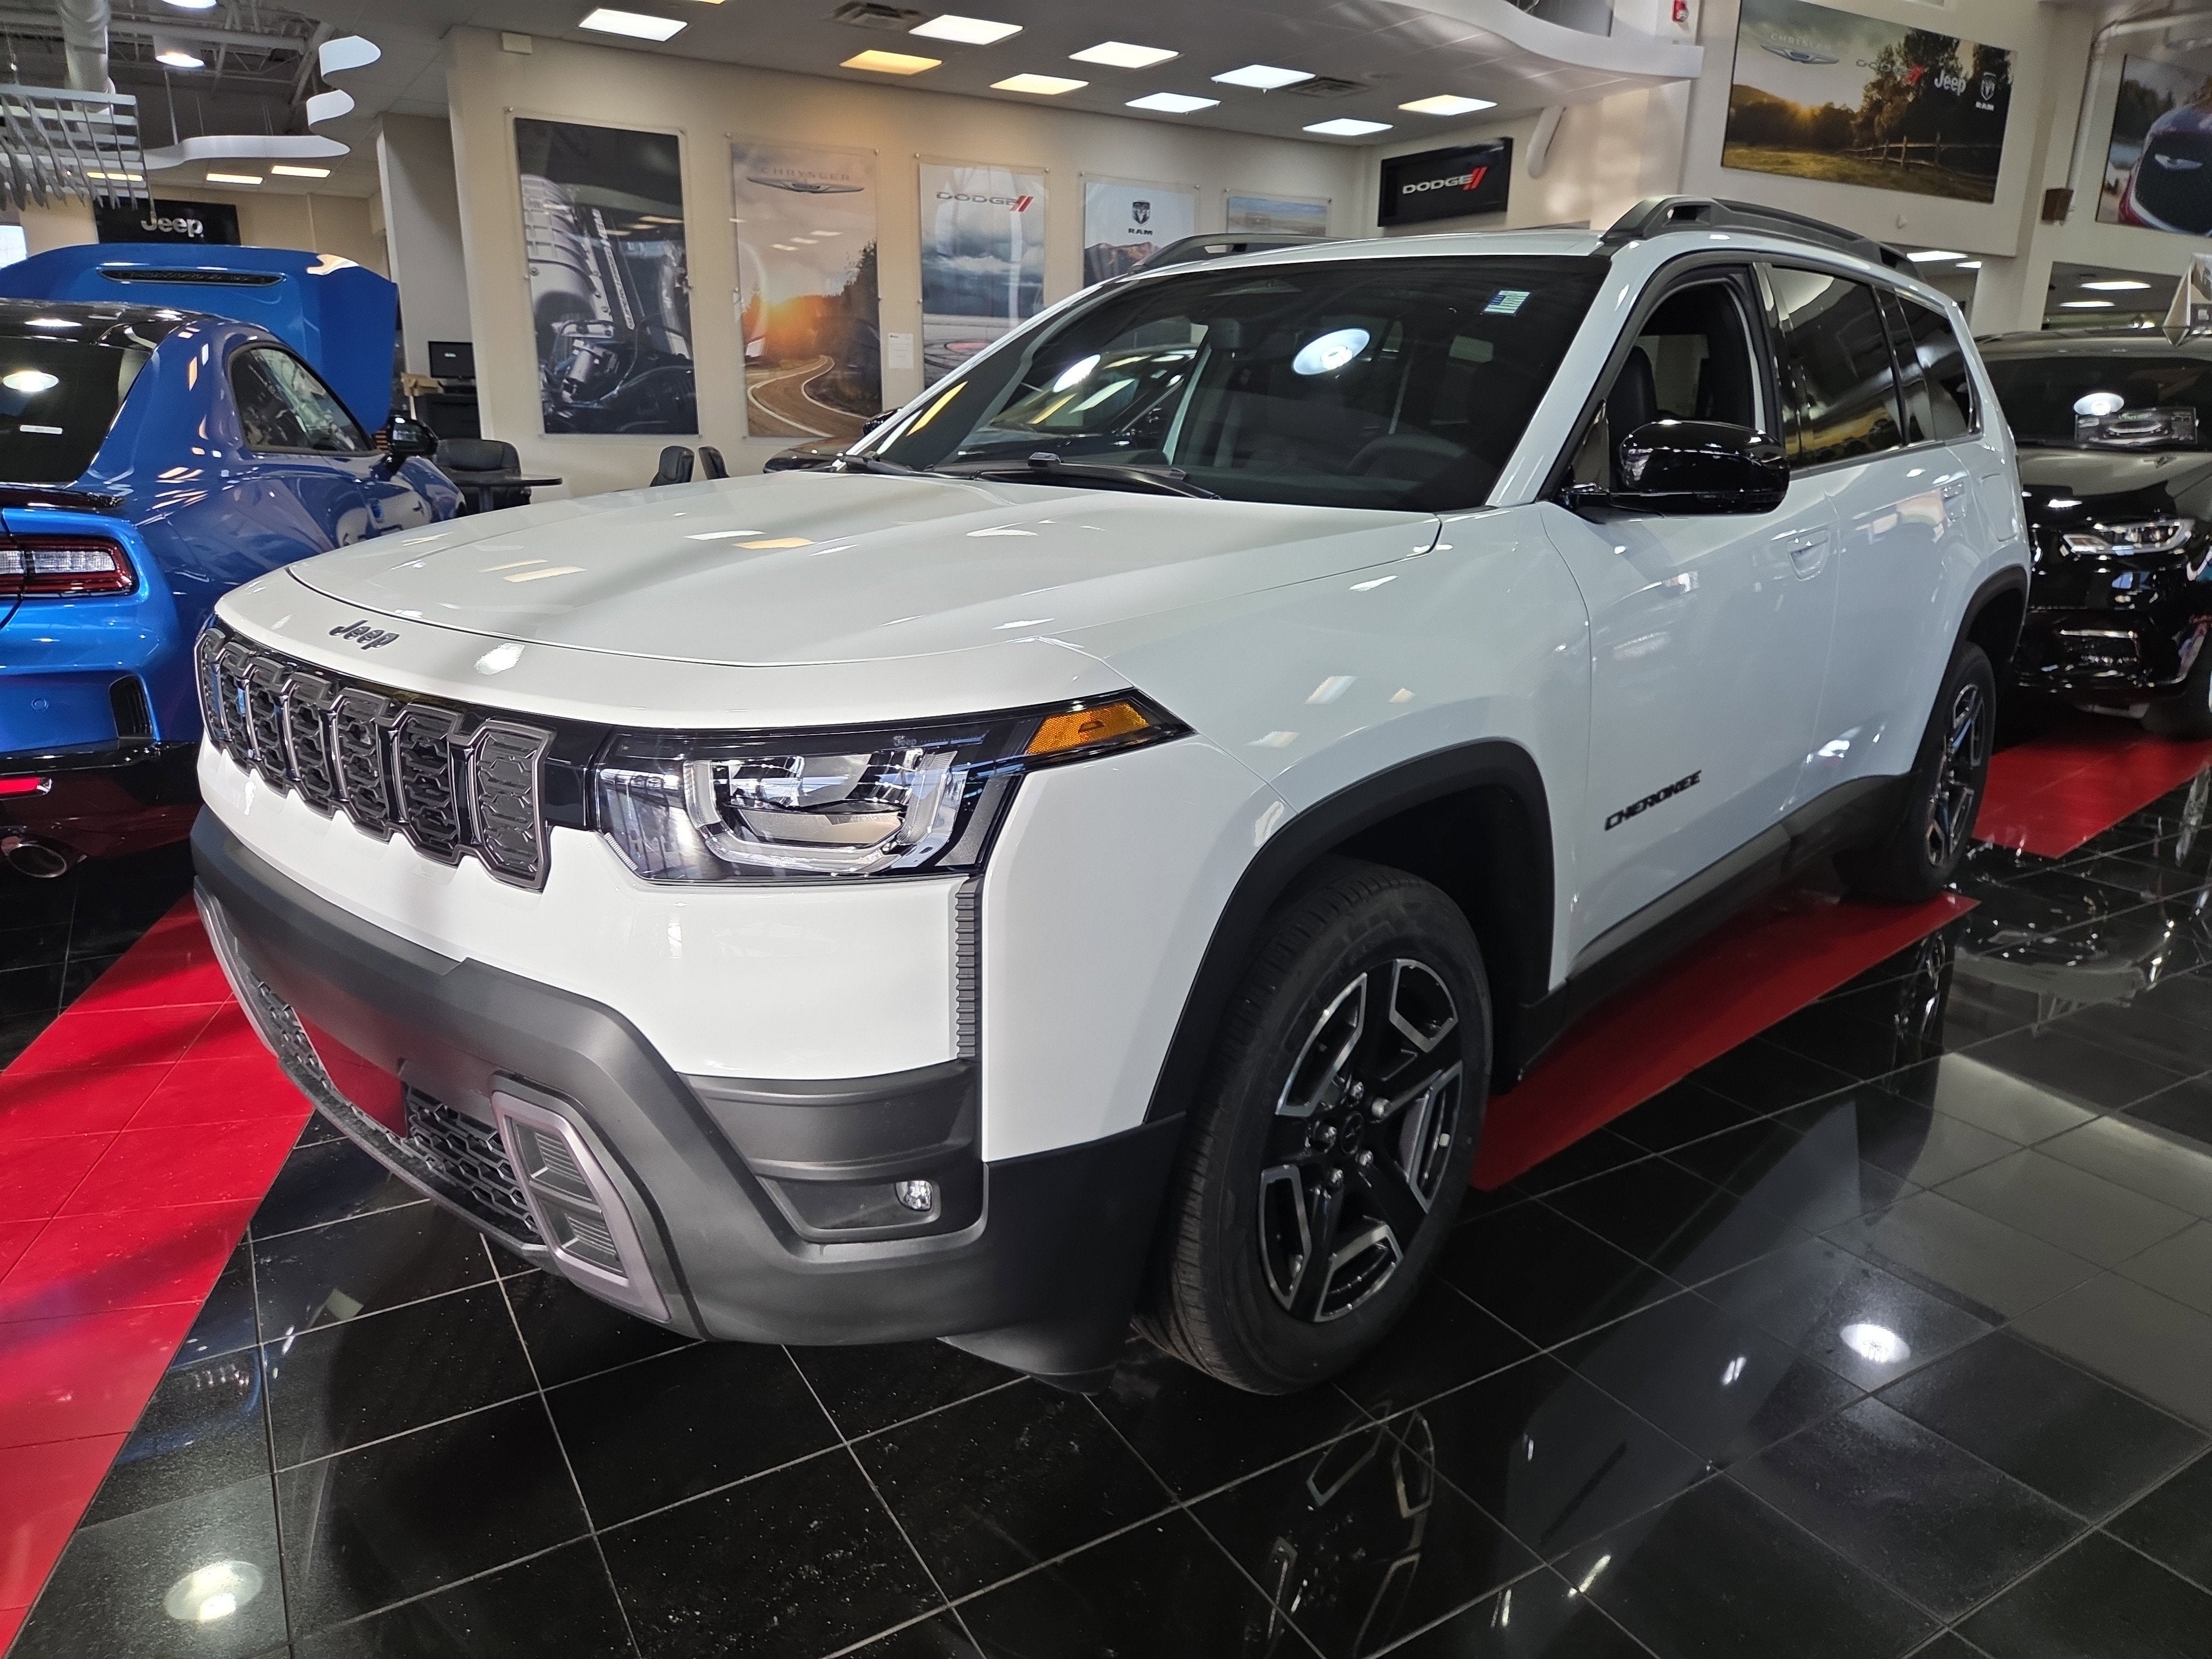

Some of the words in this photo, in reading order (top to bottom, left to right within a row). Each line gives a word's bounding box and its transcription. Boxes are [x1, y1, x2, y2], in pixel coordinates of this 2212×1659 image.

[1934, 70, 1966, 96] Jeep
[1975, 101, 1995, 111] RAM
[761, 168, 850, 182] CHRYSLER
[1403, 173, 1474, 195] DODGE
[936, 191, 1018, 206] DODGE
[141, 210, 203, 237] Jeep
[1128, 228, 1153, 236] RAM
[329, 619, 400, 650] Jeep
[1604, 769, 1702, 831] CHEROKEE
